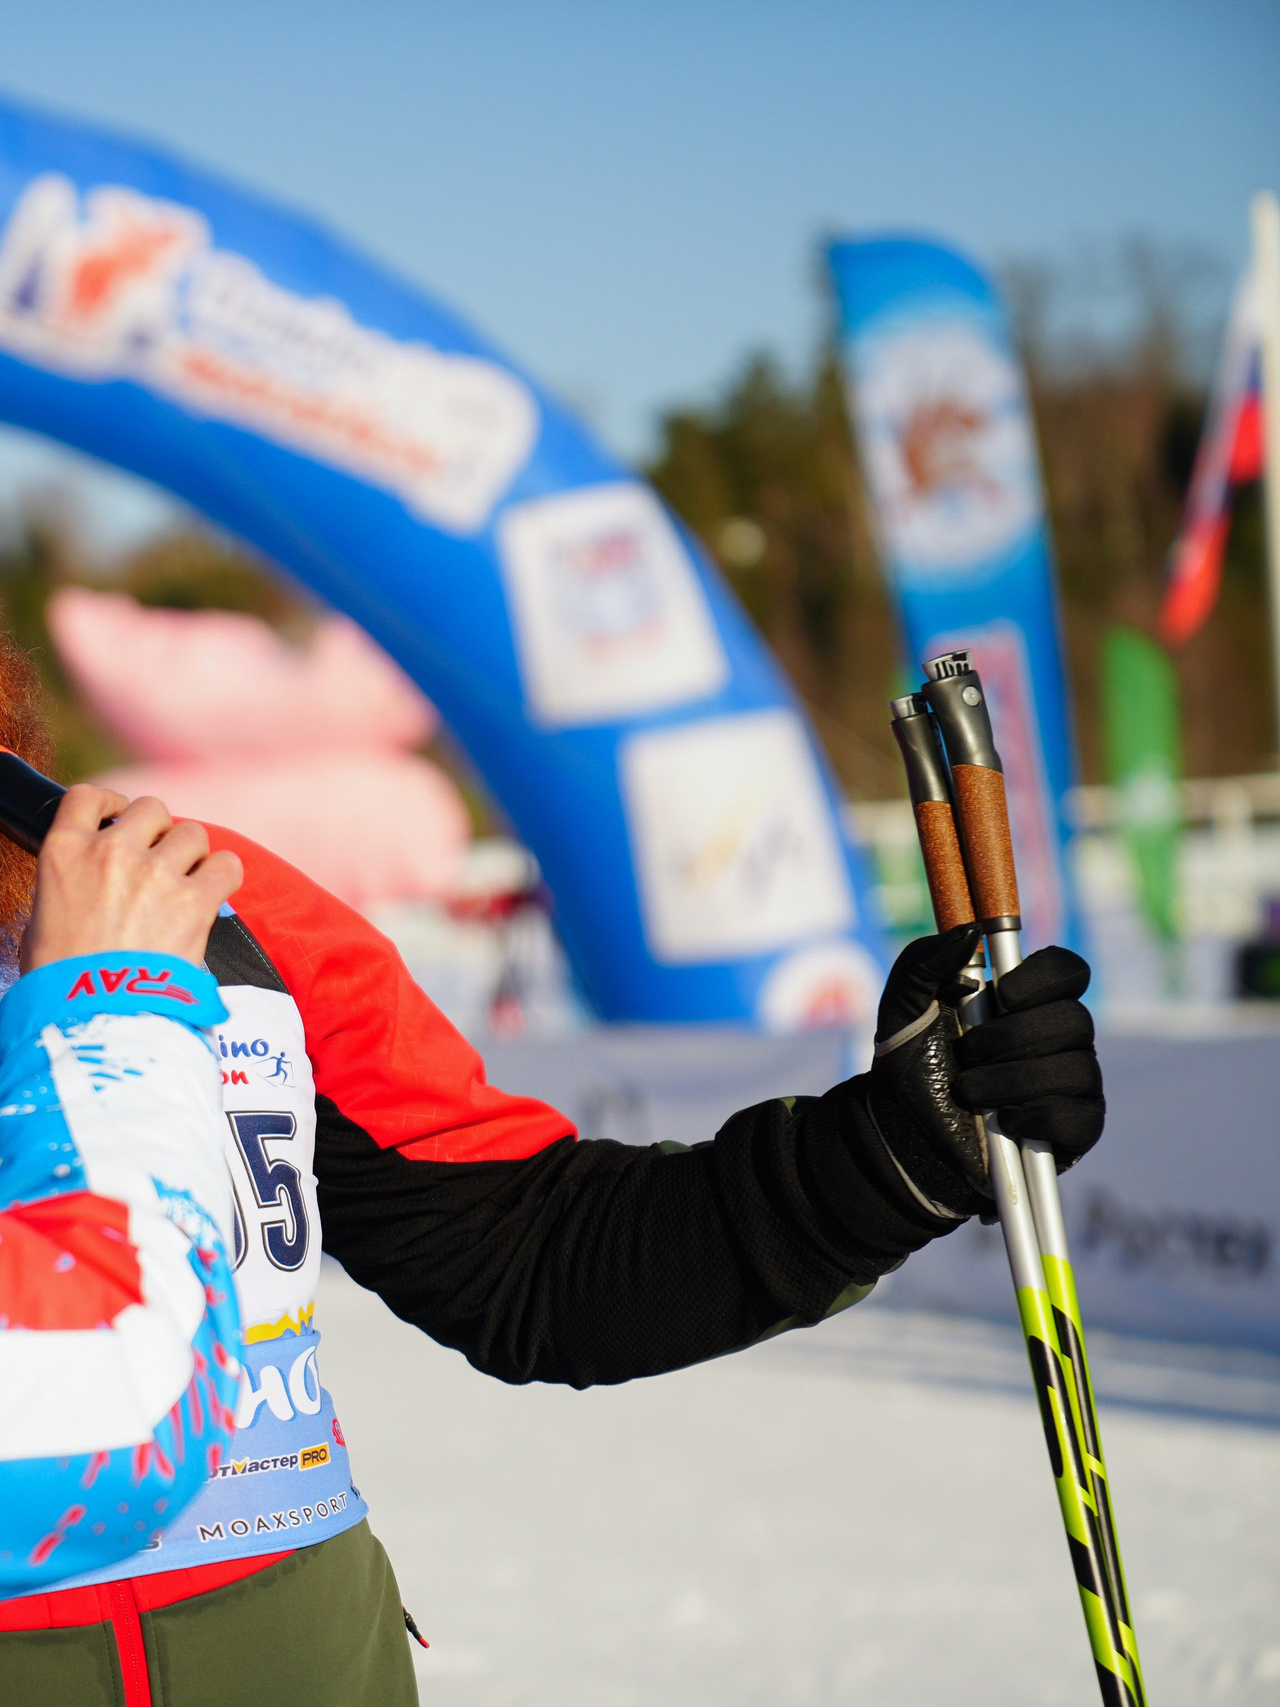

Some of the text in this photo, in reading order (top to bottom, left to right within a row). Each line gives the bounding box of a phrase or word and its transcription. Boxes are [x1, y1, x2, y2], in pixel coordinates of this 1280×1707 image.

[66, 966, 200, 1004] RAY
[218, 1034, 270, 1058] ino
[225, 1110, 310, 1272] 5
[211, 1448, 328, 1479] тМастер PRO
[199, 1493, 347, 1541] MOAXSPORT
